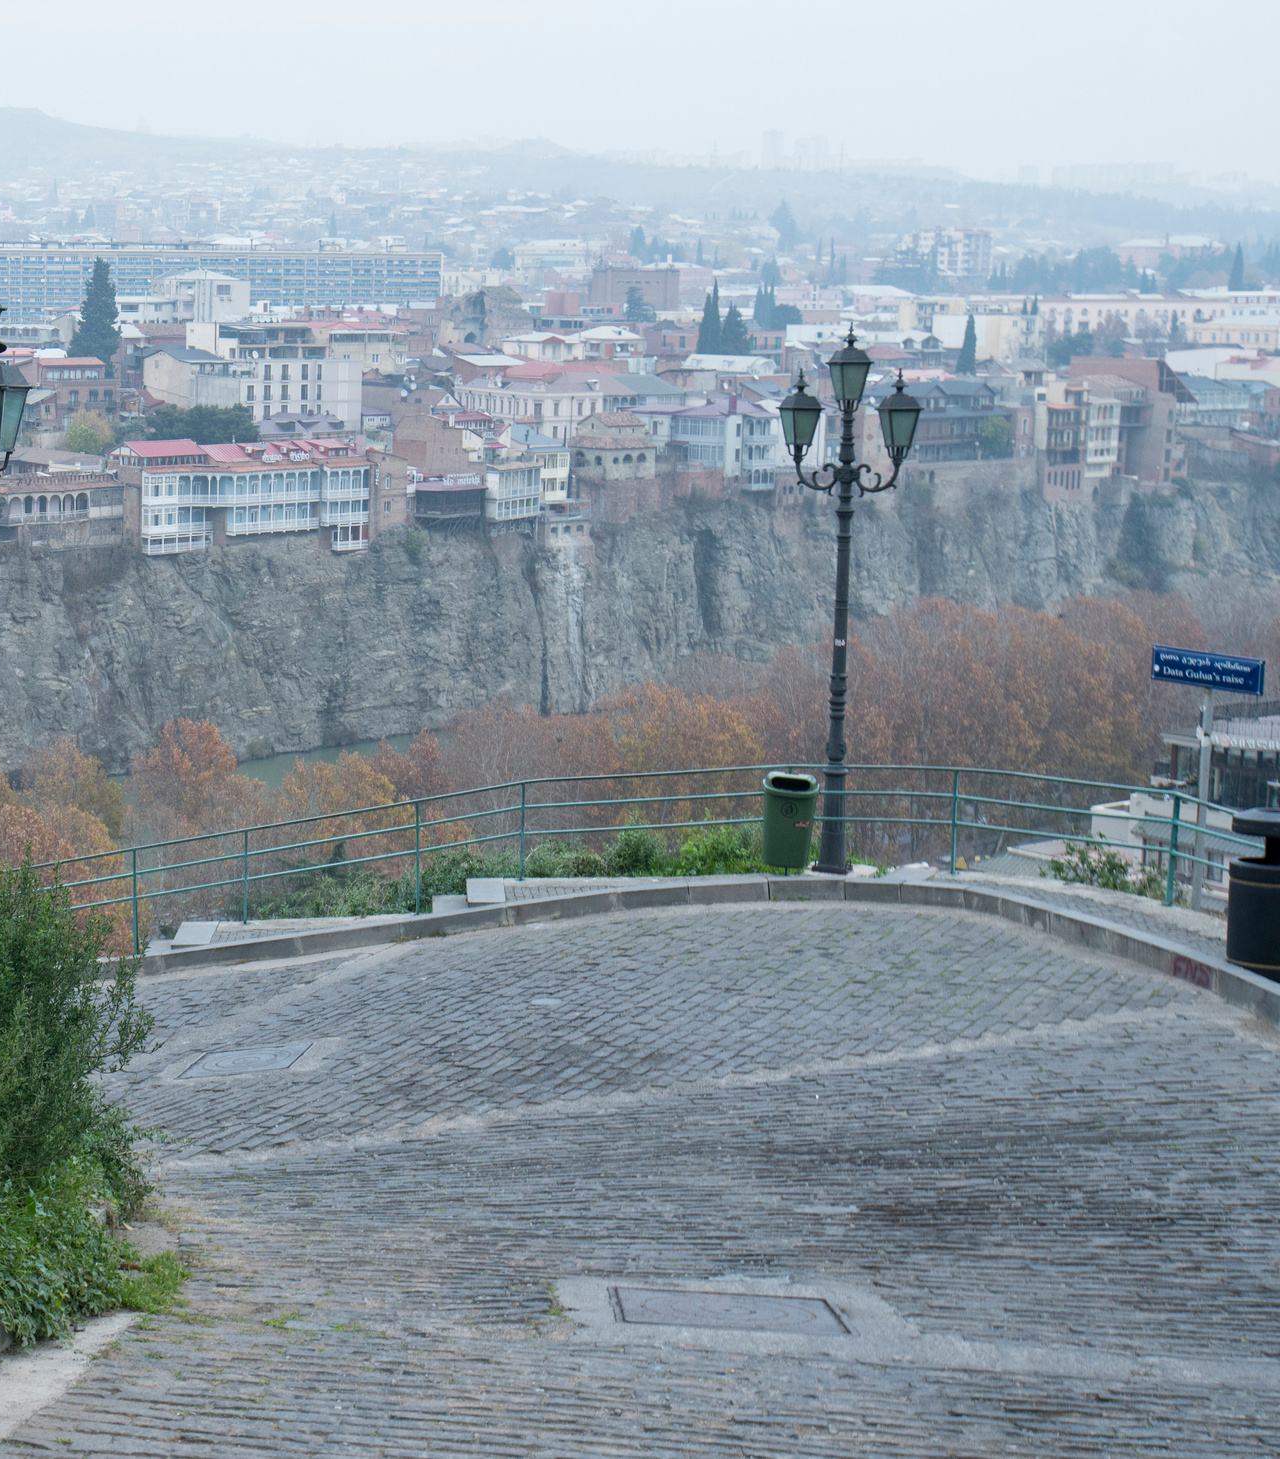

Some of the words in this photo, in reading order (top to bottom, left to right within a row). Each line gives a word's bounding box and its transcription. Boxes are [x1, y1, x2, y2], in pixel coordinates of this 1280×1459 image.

[1163, 665, 1184, 678] Data
[1185, 668, 1220, 681] Gulua's
[1222, 673, 1245, 685] raise
